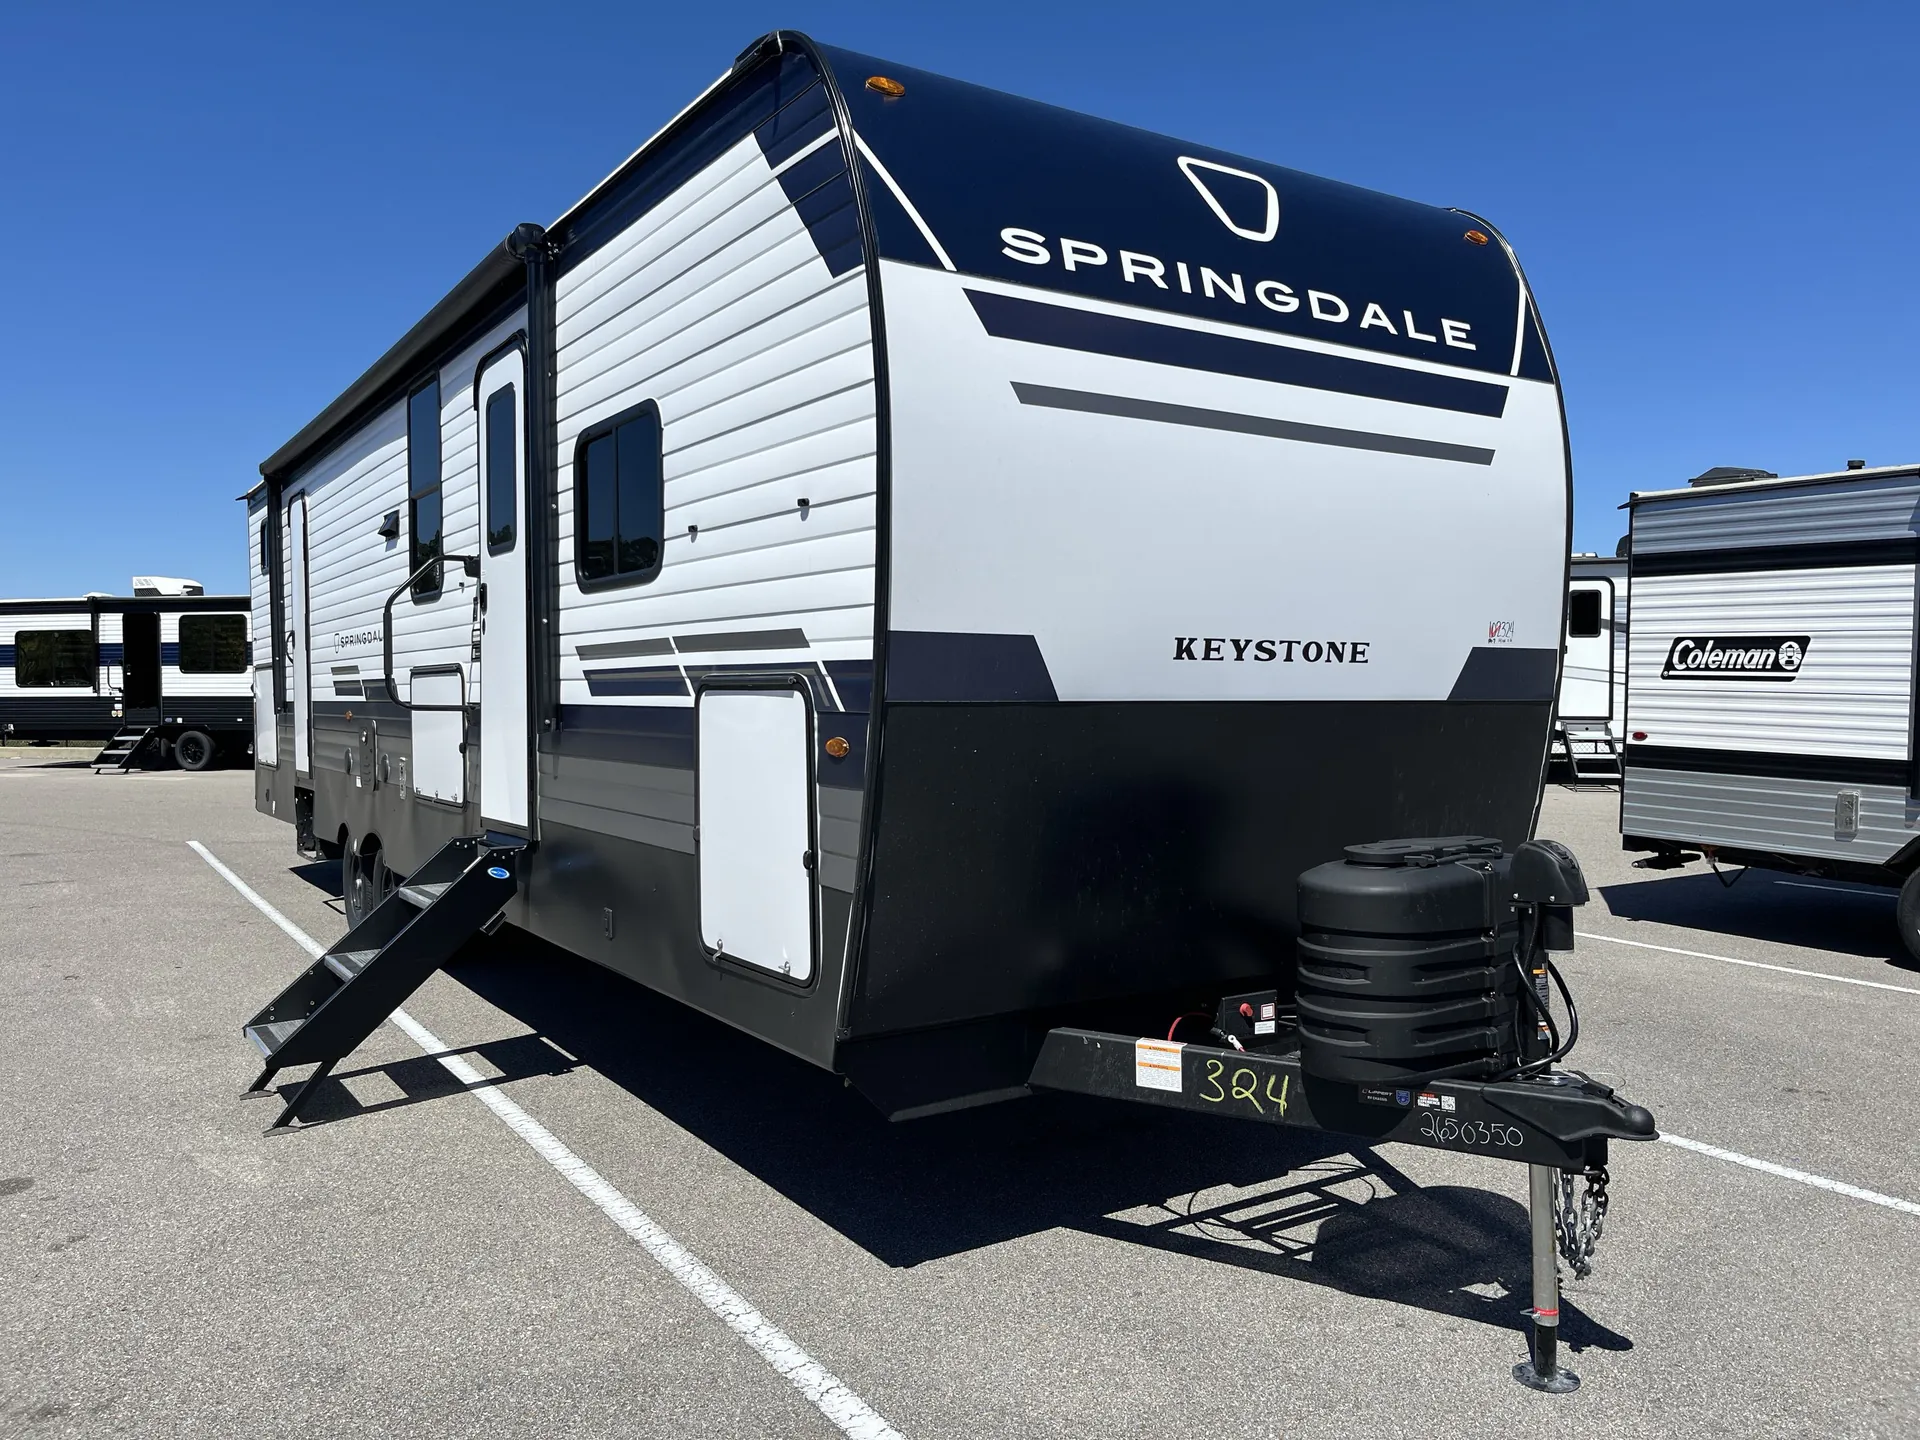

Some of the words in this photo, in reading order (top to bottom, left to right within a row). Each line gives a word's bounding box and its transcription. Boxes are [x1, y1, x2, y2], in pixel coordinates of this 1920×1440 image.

[1000, 226, 1477, 351] SPRINGDALE
[340, 629, 384, 648] SPRINGDAL
[1173, 636, 1371, 664] KEYSTONE
[1672, 639, 1777, 671] Coleman
[1199, 1059, 1289, 1117] 324
[1420, 1111, 1524, 1147] 2650350
